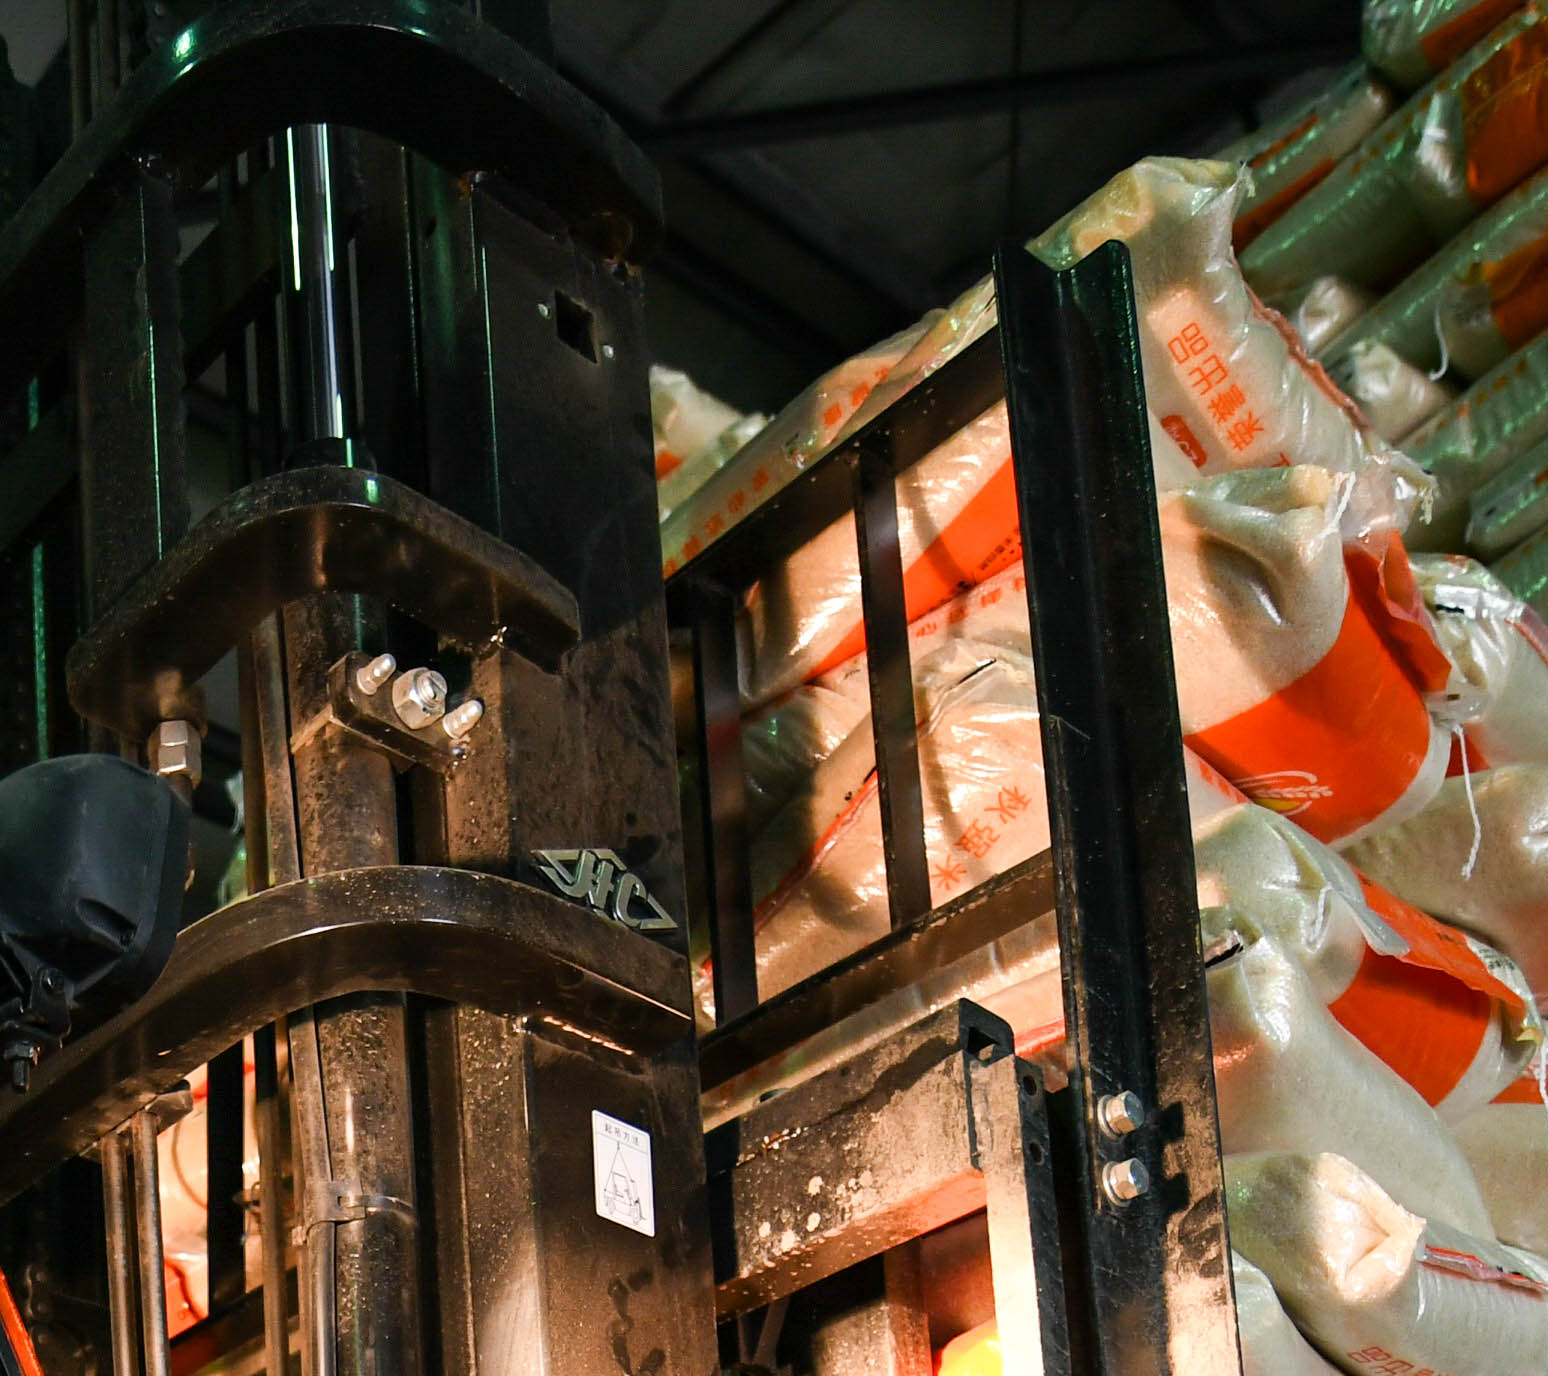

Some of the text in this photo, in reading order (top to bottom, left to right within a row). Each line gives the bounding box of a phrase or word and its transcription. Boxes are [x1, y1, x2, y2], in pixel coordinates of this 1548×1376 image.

[1167, 321, 1262, 451] 荣誉出品
[931, 786, 1032, 892] 秋强米
